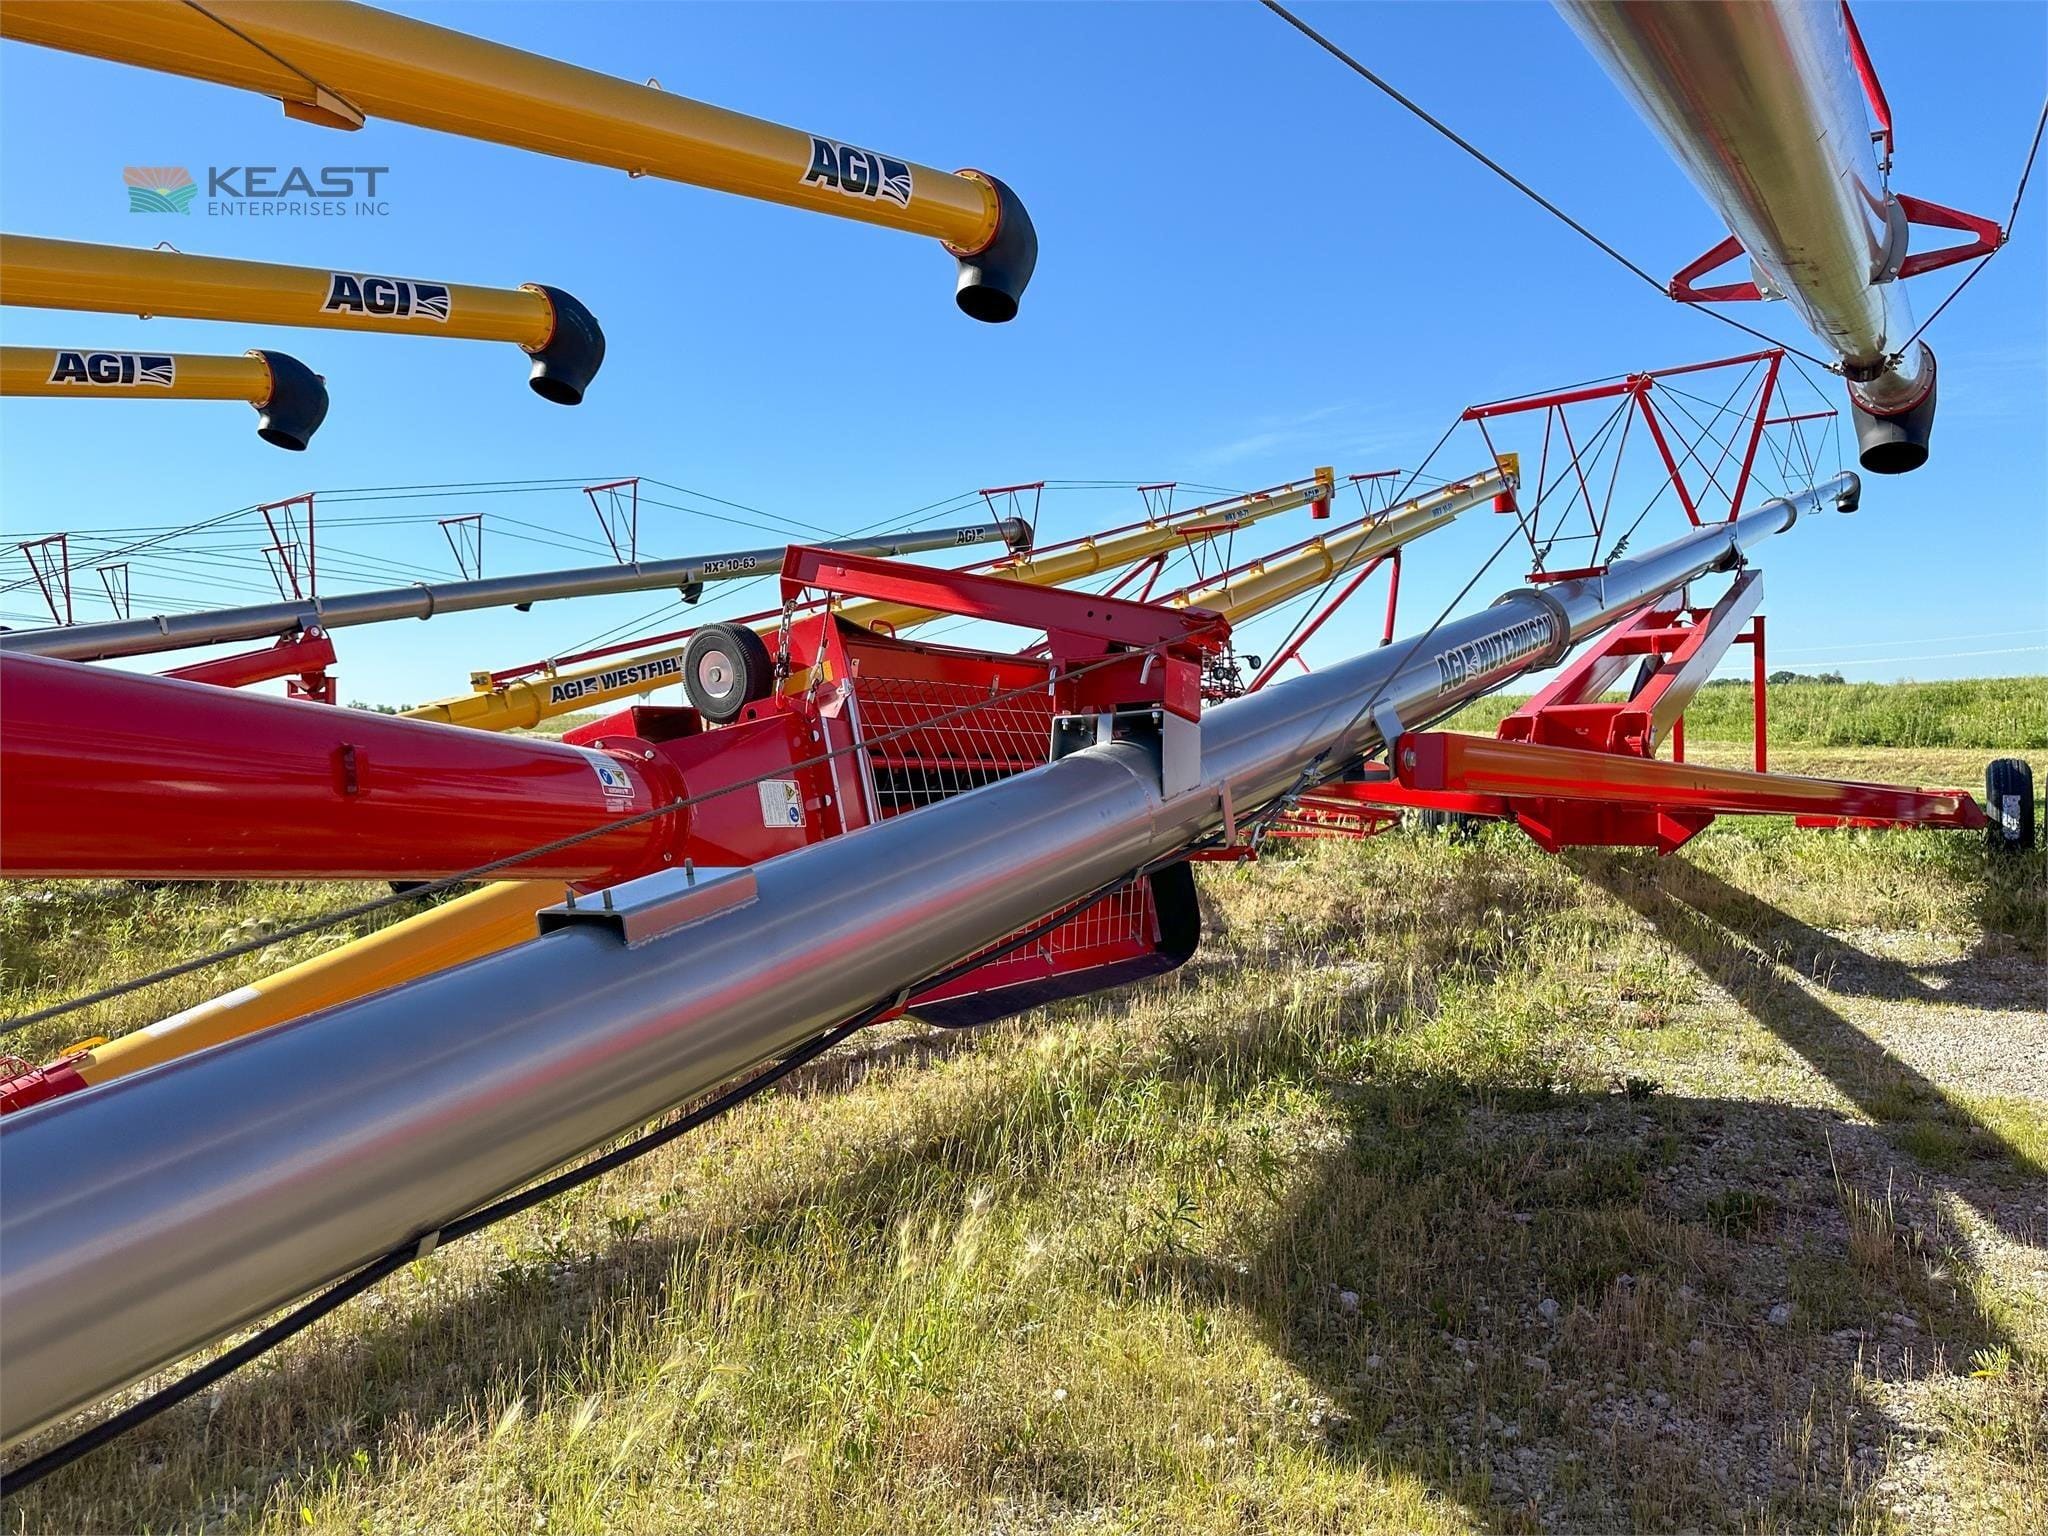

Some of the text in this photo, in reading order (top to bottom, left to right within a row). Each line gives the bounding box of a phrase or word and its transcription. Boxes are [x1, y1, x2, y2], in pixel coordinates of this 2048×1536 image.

[805, 138, 880, 197] AGI
[325, 274, 412, 316] AGI
[51, 351, 135, 385] AGI
[956, 529, 976, 544] AGI
[727, 557, 756, 571] 10-63
[1435, 614, 1553, 694] AGI HUTCHINSON
[551, 680, 584, 704] AGI
